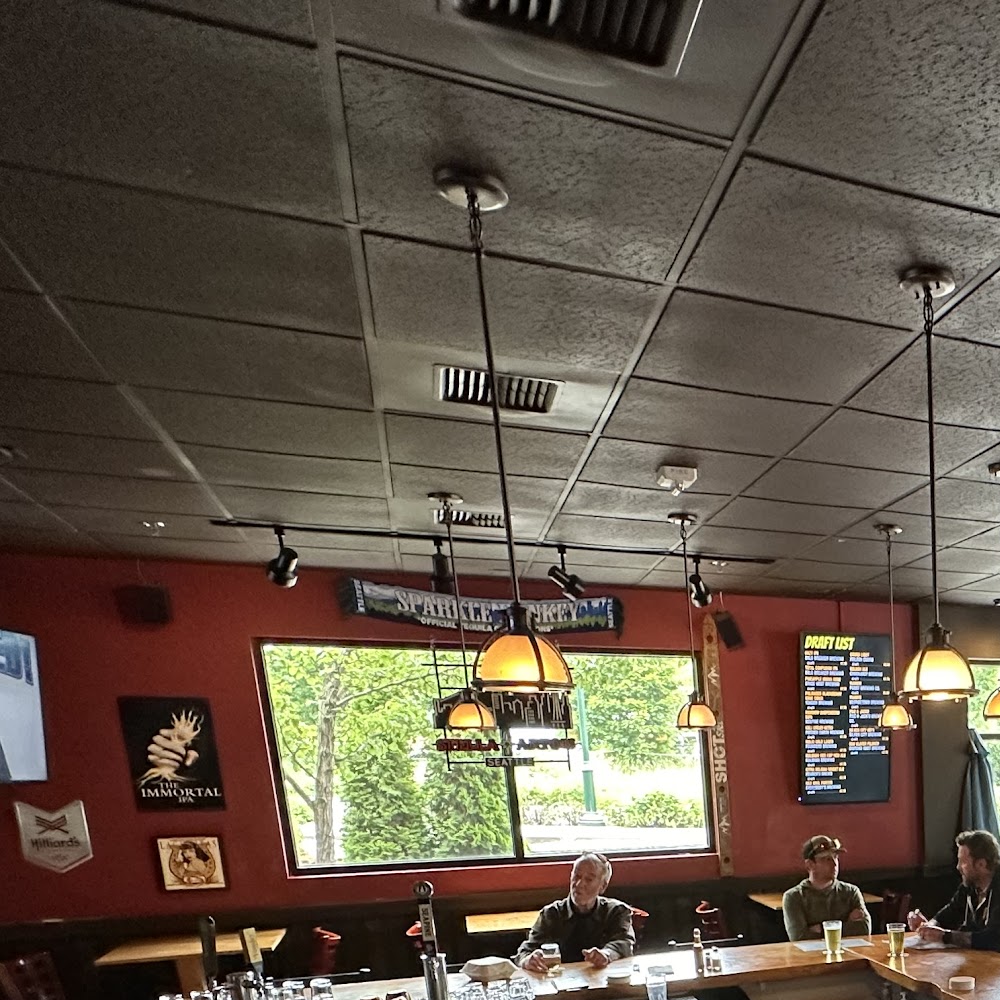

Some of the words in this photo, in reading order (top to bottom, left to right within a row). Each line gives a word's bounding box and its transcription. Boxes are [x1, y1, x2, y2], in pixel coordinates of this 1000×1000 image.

[394, 589, 492, 623] SPARKLE
[527, 602, 580, 623] NKEY
[804, 635, 835, 650] DRAFT
[834, 636, 856, 651] LIST
[487, 757, 533, 768] SEATTLE
[141, 787, 222, 798] IMMORTAL
[30, 836, 81, 851] Hilliard's
